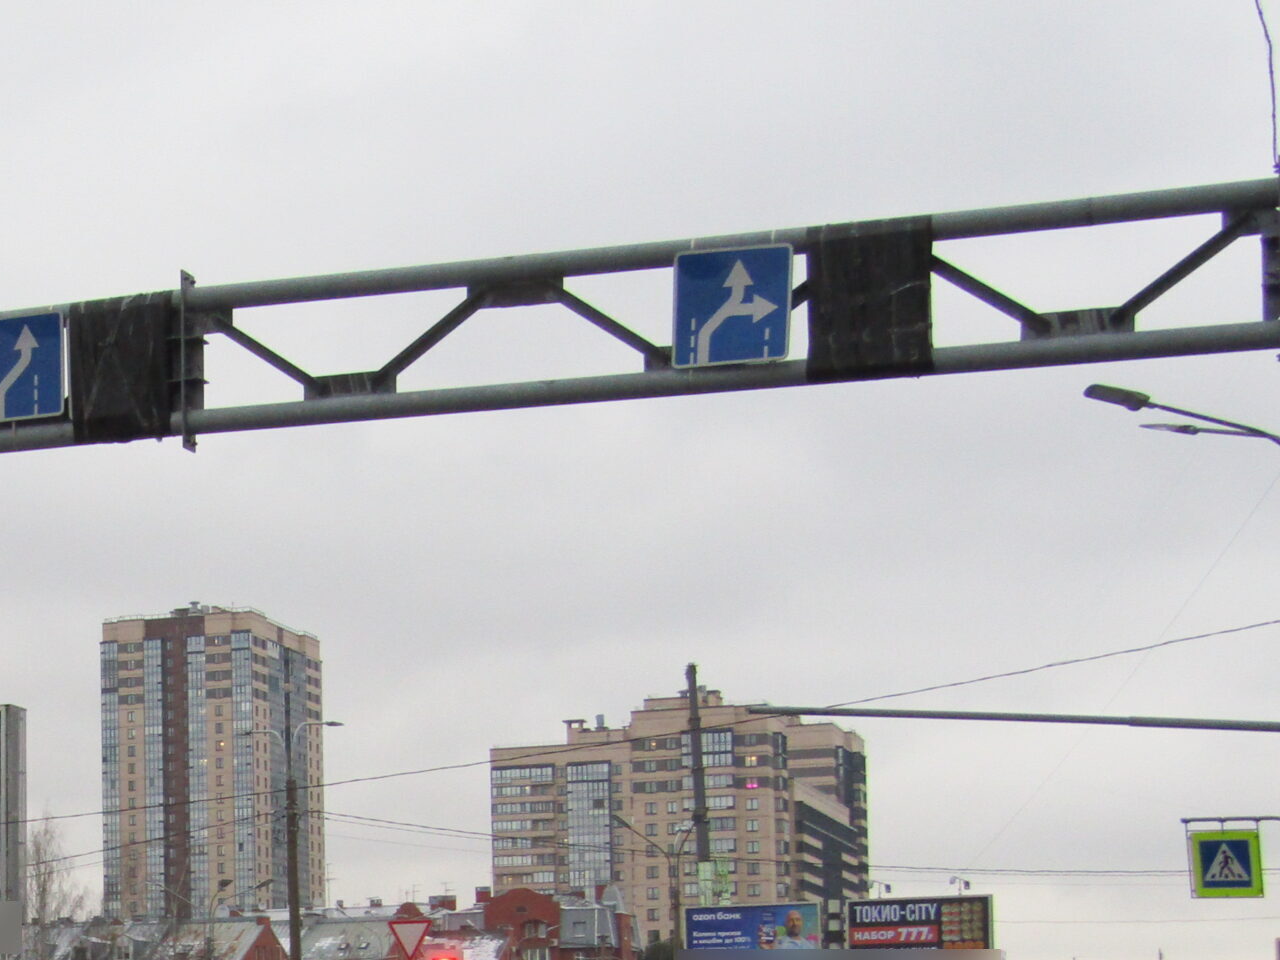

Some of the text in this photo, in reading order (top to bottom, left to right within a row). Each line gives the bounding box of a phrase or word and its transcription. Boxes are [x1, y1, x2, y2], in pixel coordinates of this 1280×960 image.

[692, 911, 741, 921] ozon банк
[854, 930, 896, 941] НАБОР
